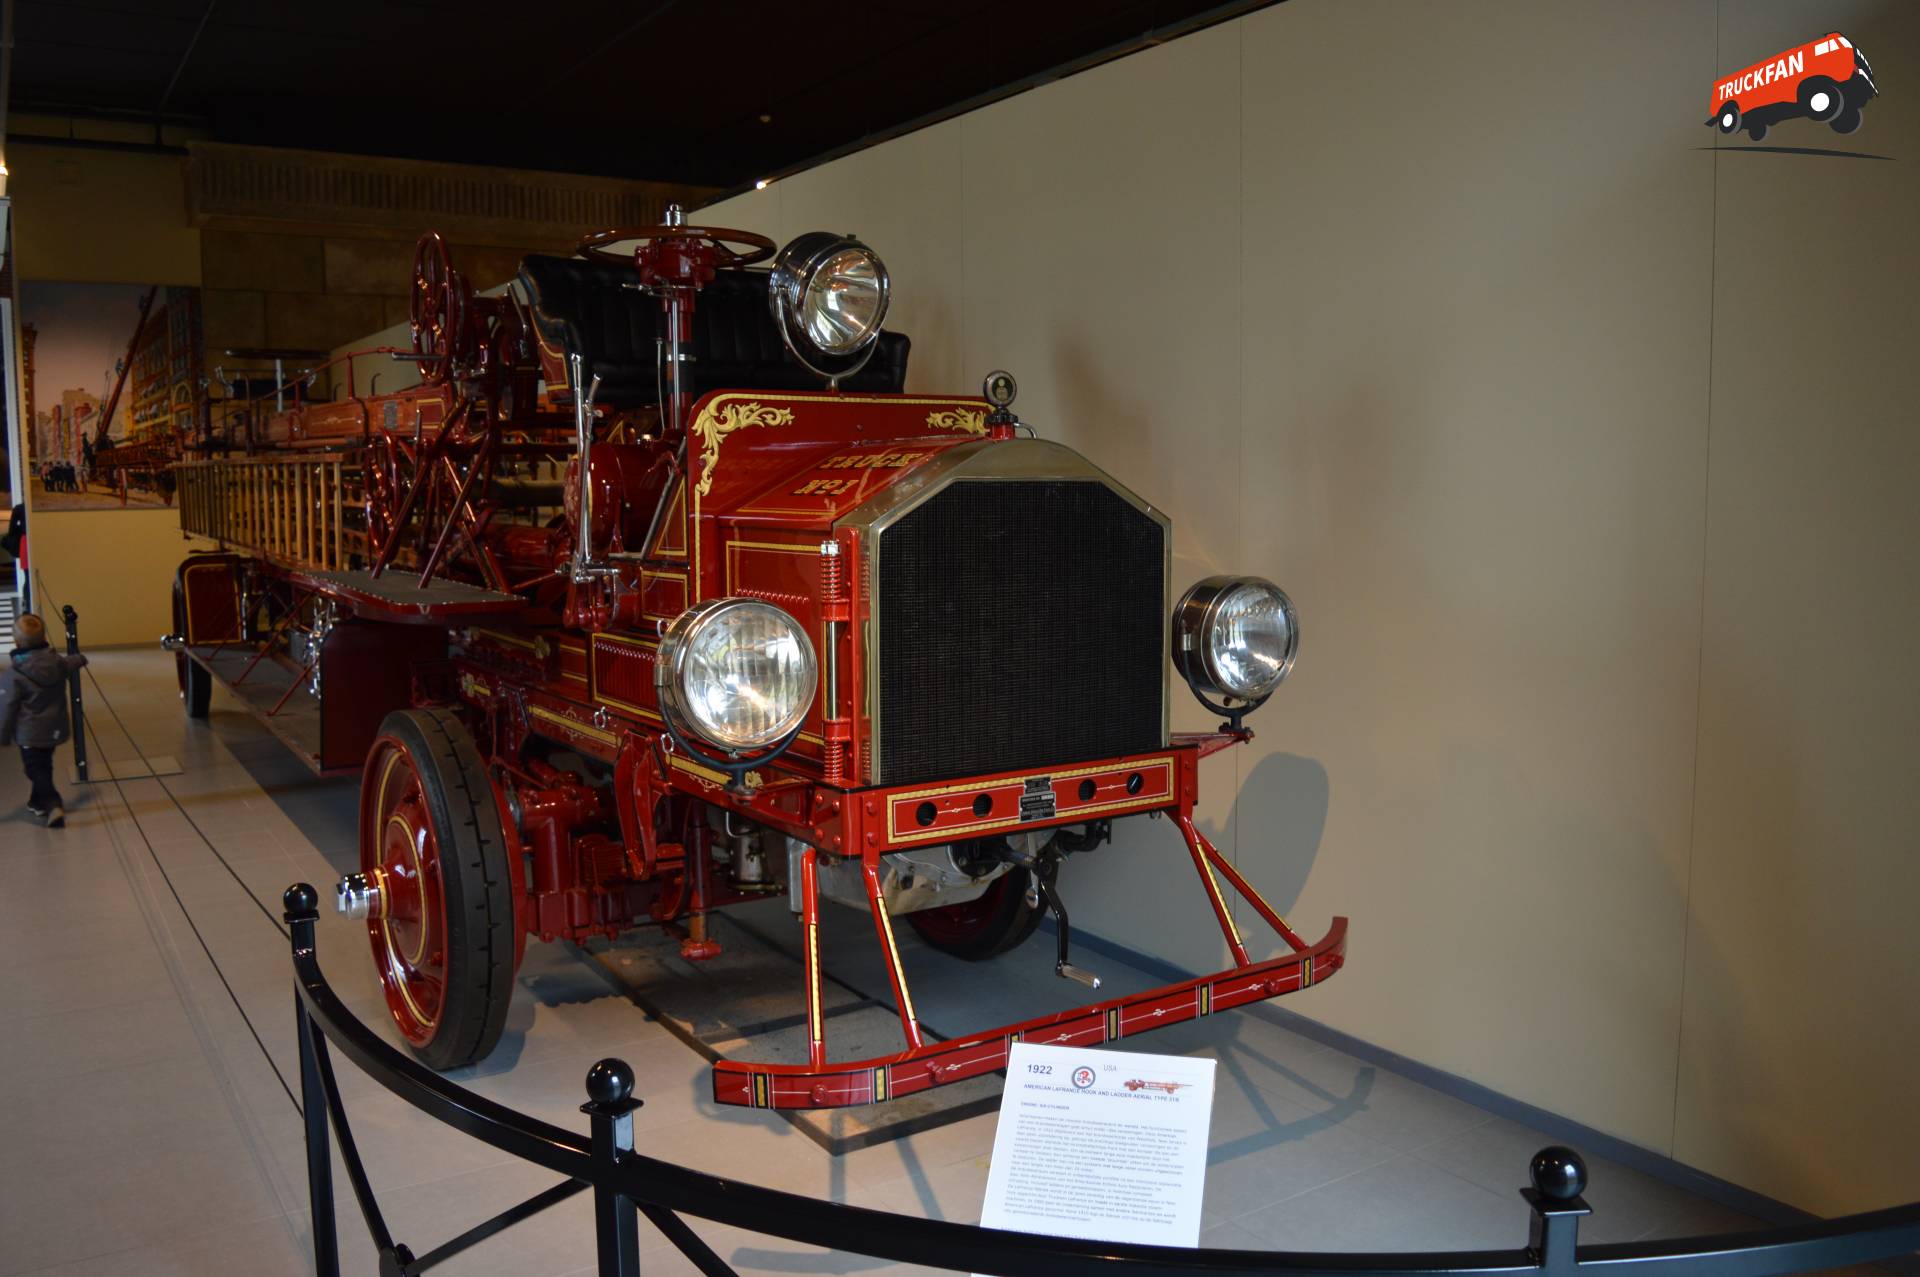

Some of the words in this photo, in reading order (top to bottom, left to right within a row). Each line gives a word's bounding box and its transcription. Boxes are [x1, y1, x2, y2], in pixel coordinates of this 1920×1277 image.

[819, 453, 923, 469] TRUCK
[1027, 1064, 1053, 1075] 1922
[1103, 1064, 1117, 1072] USA
[1024, 1083, 1051, 1091] AMERICAN
